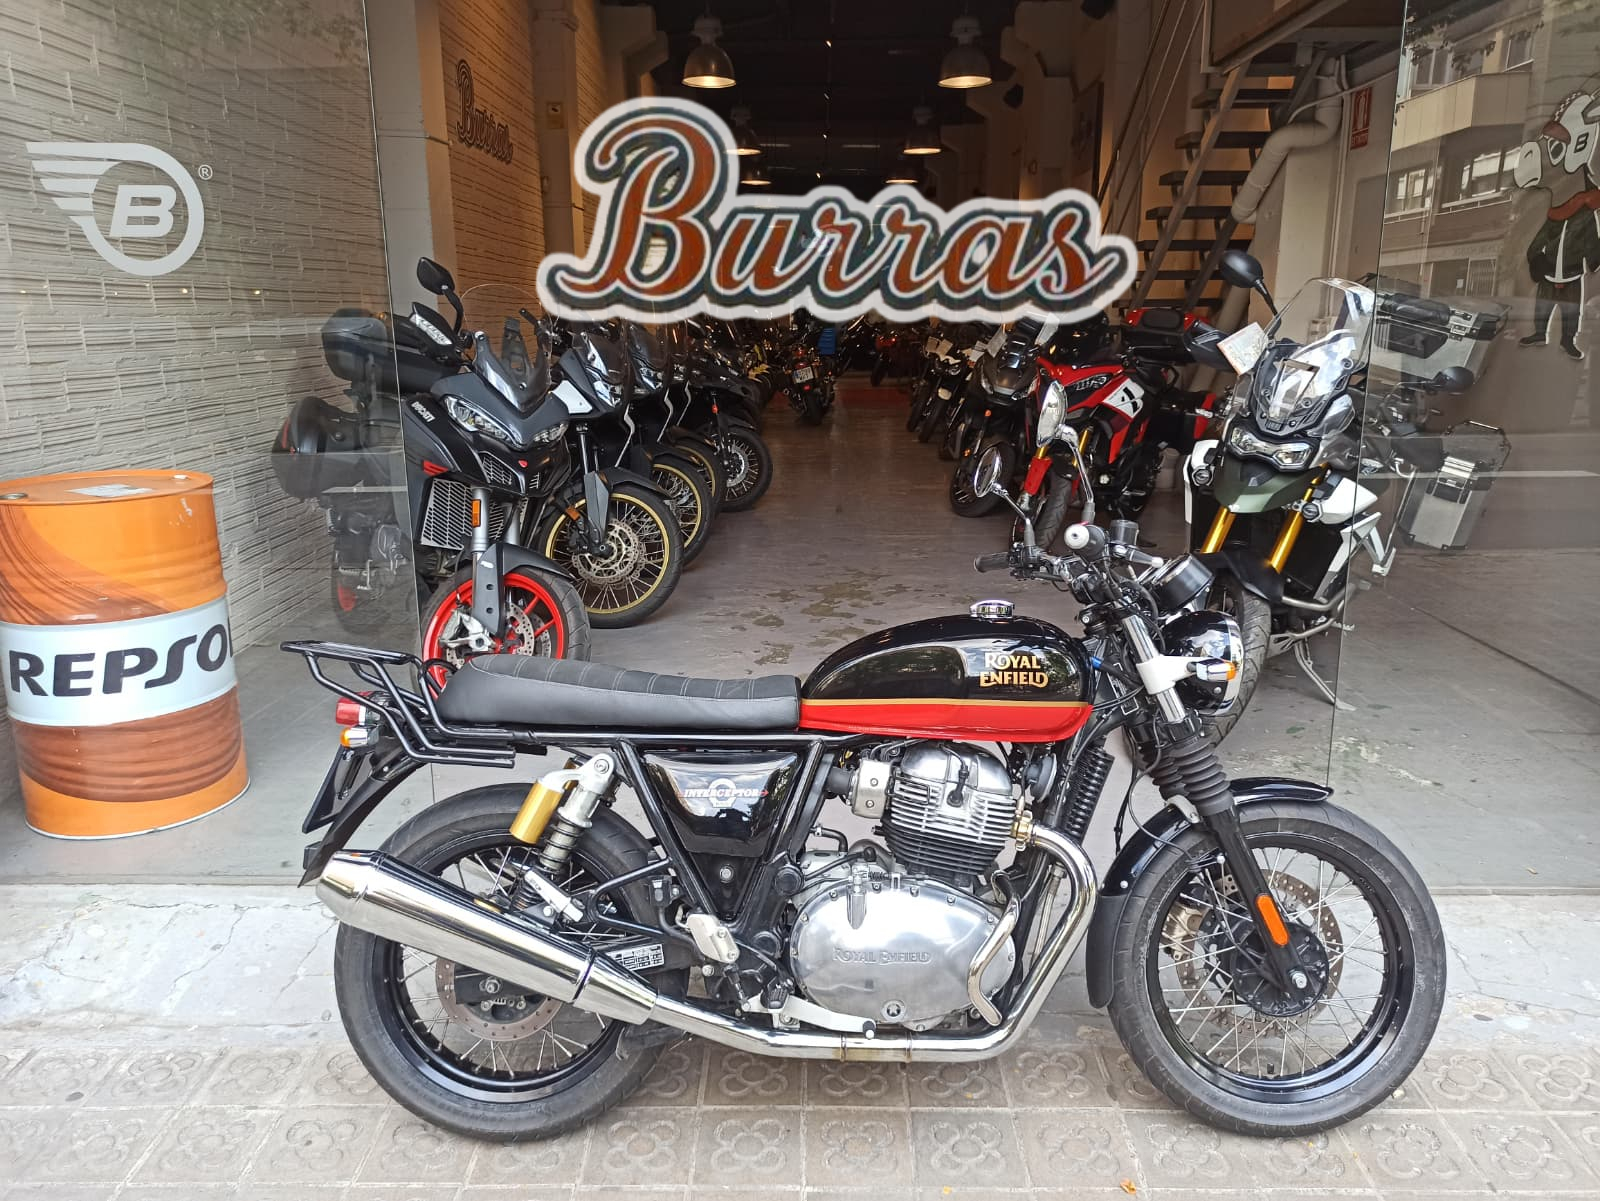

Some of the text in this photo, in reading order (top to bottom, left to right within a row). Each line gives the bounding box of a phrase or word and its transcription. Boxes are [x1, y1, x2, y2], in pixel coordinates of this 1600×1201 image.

[109, 185, 177, 237] B
[9, 623, 233, 697] REPSO
[984, 652, 1041, 670] ROYAL
[980, 671, 1049, 688] ENFIELD
[684, 788, 760, 798] INTERCEPTOR
[833, 947, 932, 966] ROYAL ENFIELD
